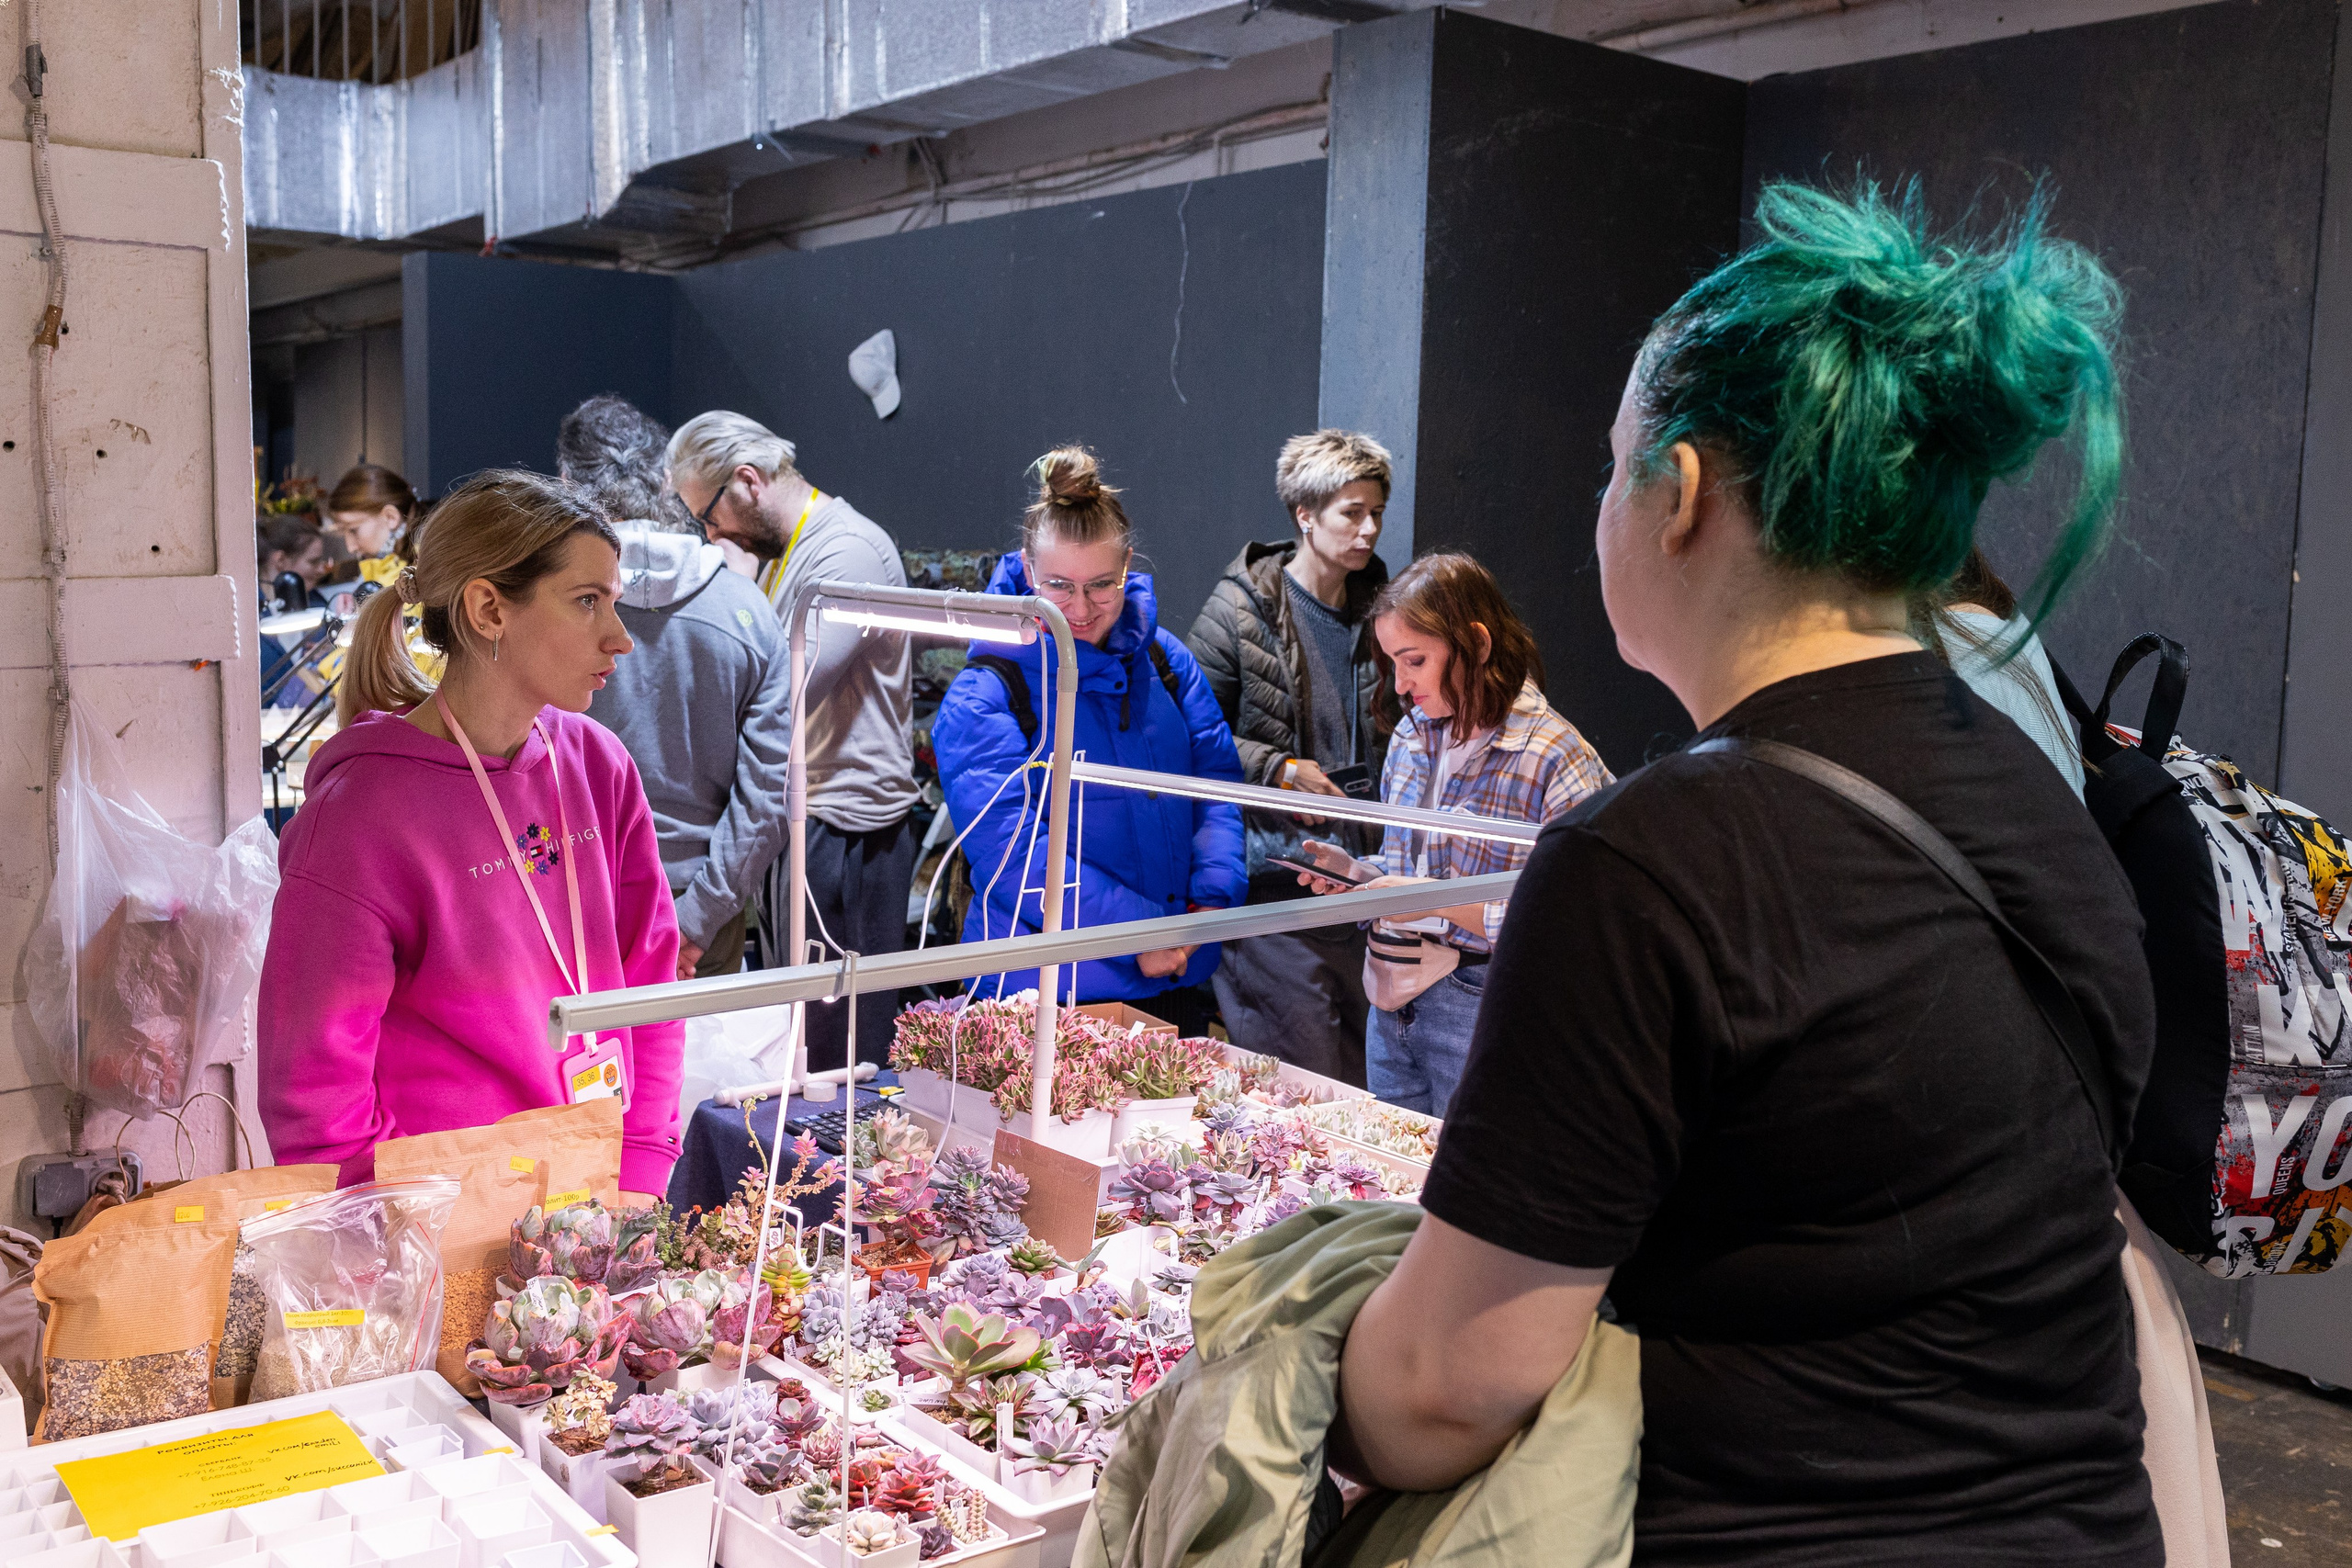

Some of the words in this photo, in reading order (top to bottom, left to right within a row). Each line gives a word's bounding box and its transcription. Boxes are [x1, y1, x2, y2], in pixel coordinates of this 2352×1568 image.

[469, 849, 527, 879] TOMY
[546, 826, 602, 855] HIFIGE
[2324, 878, 2348, 910] YORK
[2321, 913, 2338, 942] NEW
[2242, 1024, 2264, 1064] ATTAN
[2272, 1156, 2296, 1196] QUEENS
[546, 1193, 580, 1206] олит-100р
